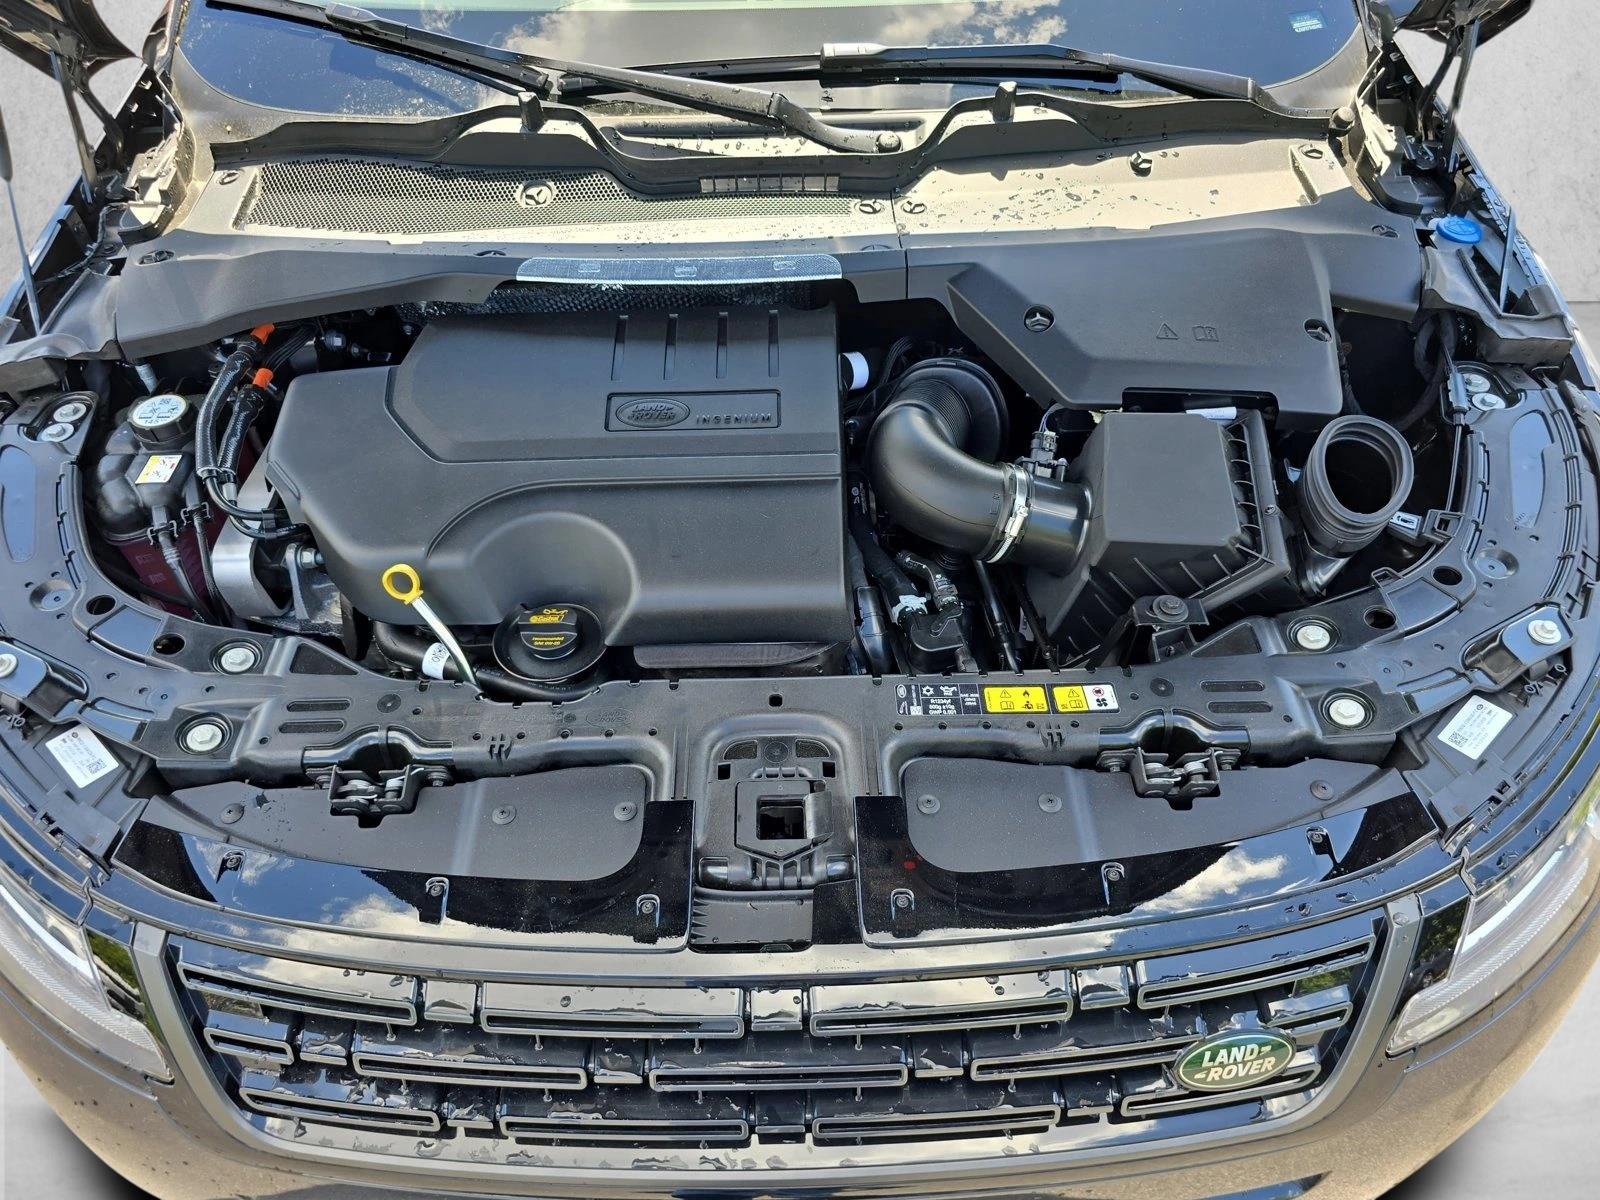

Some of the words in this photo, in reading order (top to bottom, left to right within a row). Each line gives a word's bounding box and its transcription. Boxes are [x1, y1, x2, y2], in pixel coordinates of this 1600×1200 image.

[632, 403, 666, 412] LAND
[632, 412, 676, 421] ROVER
[696, 413, 772, 425] INGENIUM
[1201, 1043, 1259, 1067] LAND
[1206, 1057, 1276, 1081] ROVER
